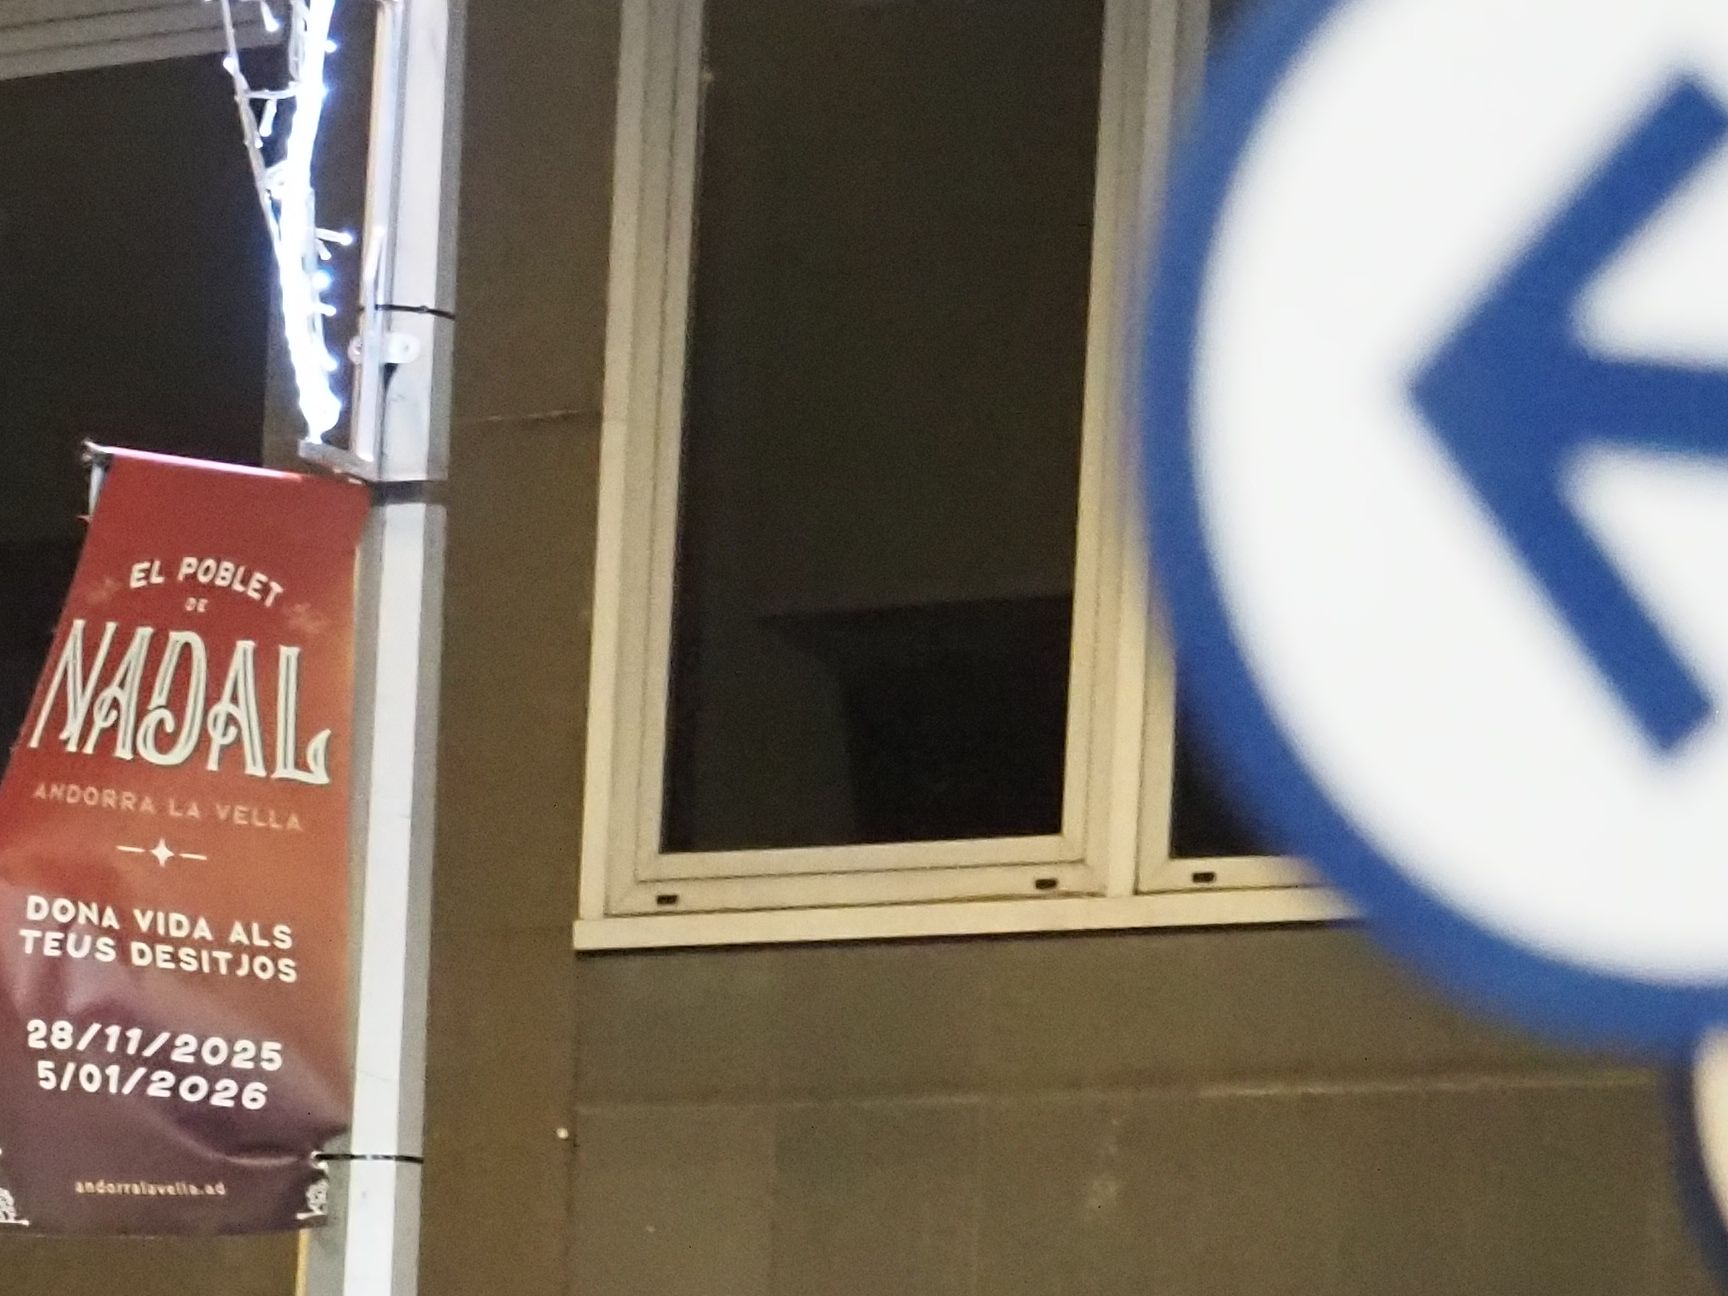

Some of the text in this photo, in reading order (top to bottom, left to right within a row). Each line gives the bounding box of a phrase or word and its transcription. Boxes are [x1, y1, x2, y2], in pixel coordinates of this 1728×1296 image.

[129, 556, 285, 608] EL POBLET
[184, 597, 208, 613] DE
[27, 618, 332, 785] NADAL
[31, 782, 304, 832] ANDORRA LA VELLA
[25, 894, 294, 950] DONA VIDA ALS
[18, 928, 298, 984] TEUS DESITJOS
[26, 1018, 283, 1071] 28/11/2025
[37, 1059, 269, 1111] 5/01/2026
